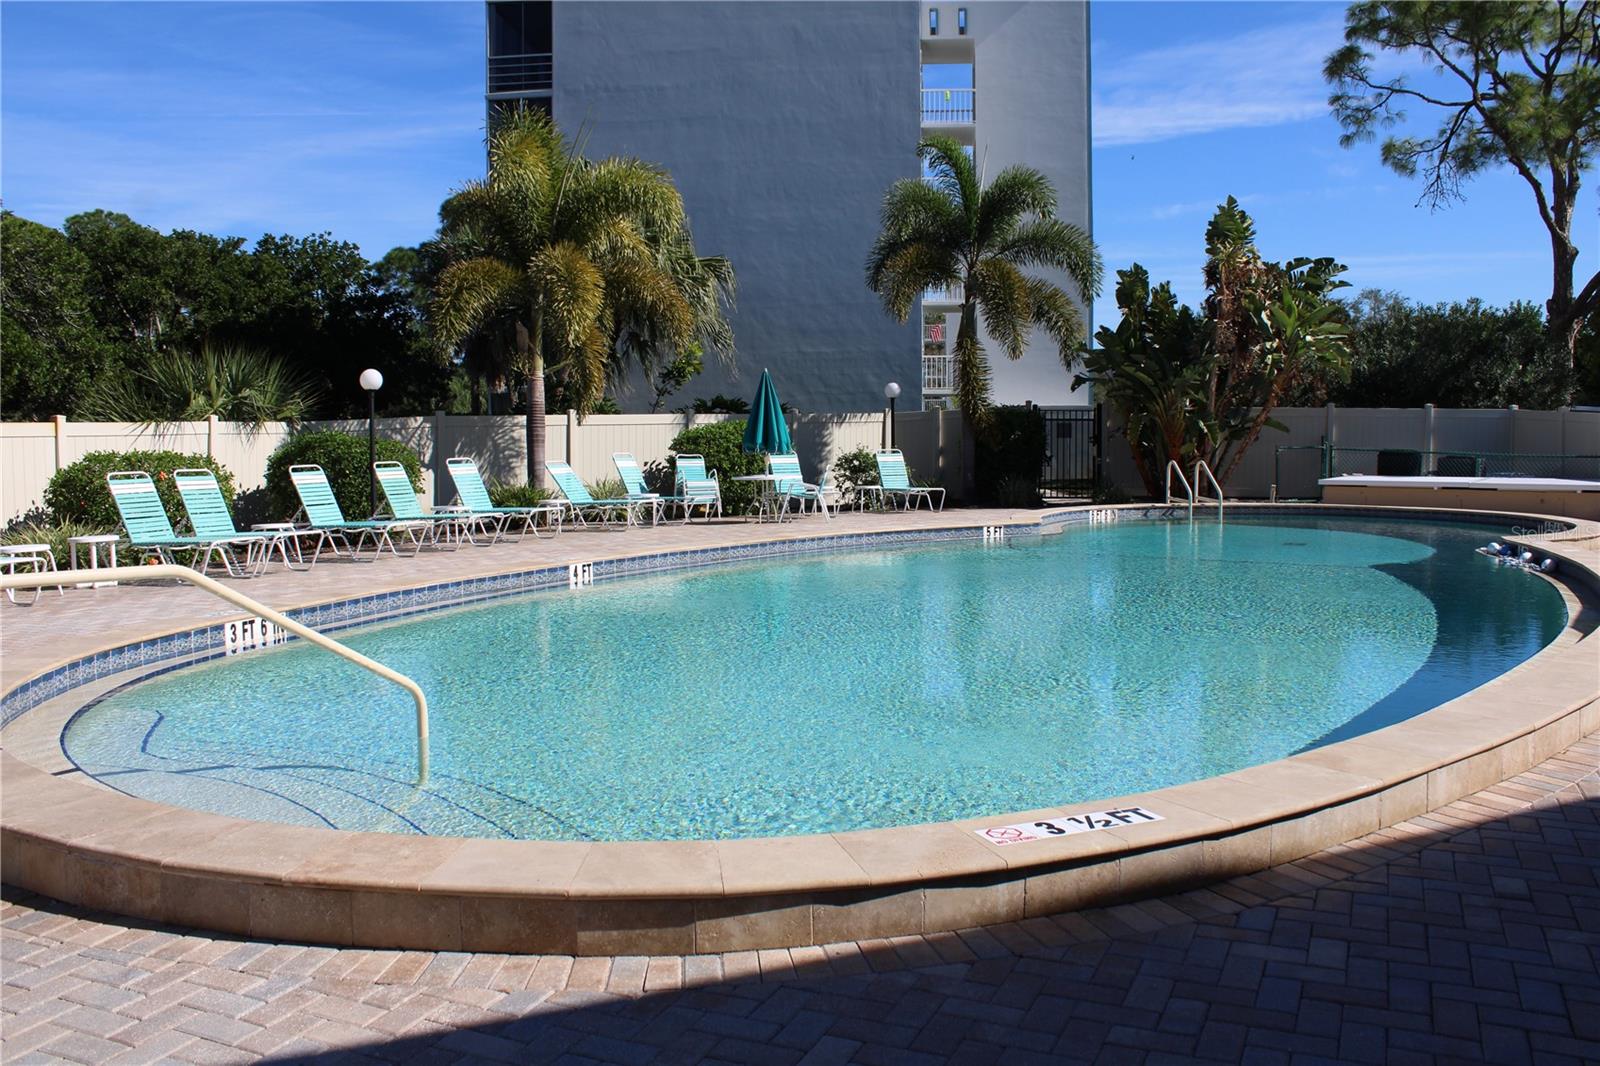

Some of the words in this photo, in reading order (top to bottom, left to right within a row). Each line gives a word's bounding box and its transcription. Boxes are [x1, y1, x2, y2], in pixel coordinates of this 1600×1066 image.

[994, 526, 1002, 537] FT
[573, 565, 578, 580] 4
[582, 563, 591, 579] FT
[230, 623, 237, 643] 3
[242, 619, 256, 641] FT
[261, 619, 267, 636] 6
[1034, 822, 1066, 836] 3
[1105, 807, 1154, 824] FT
